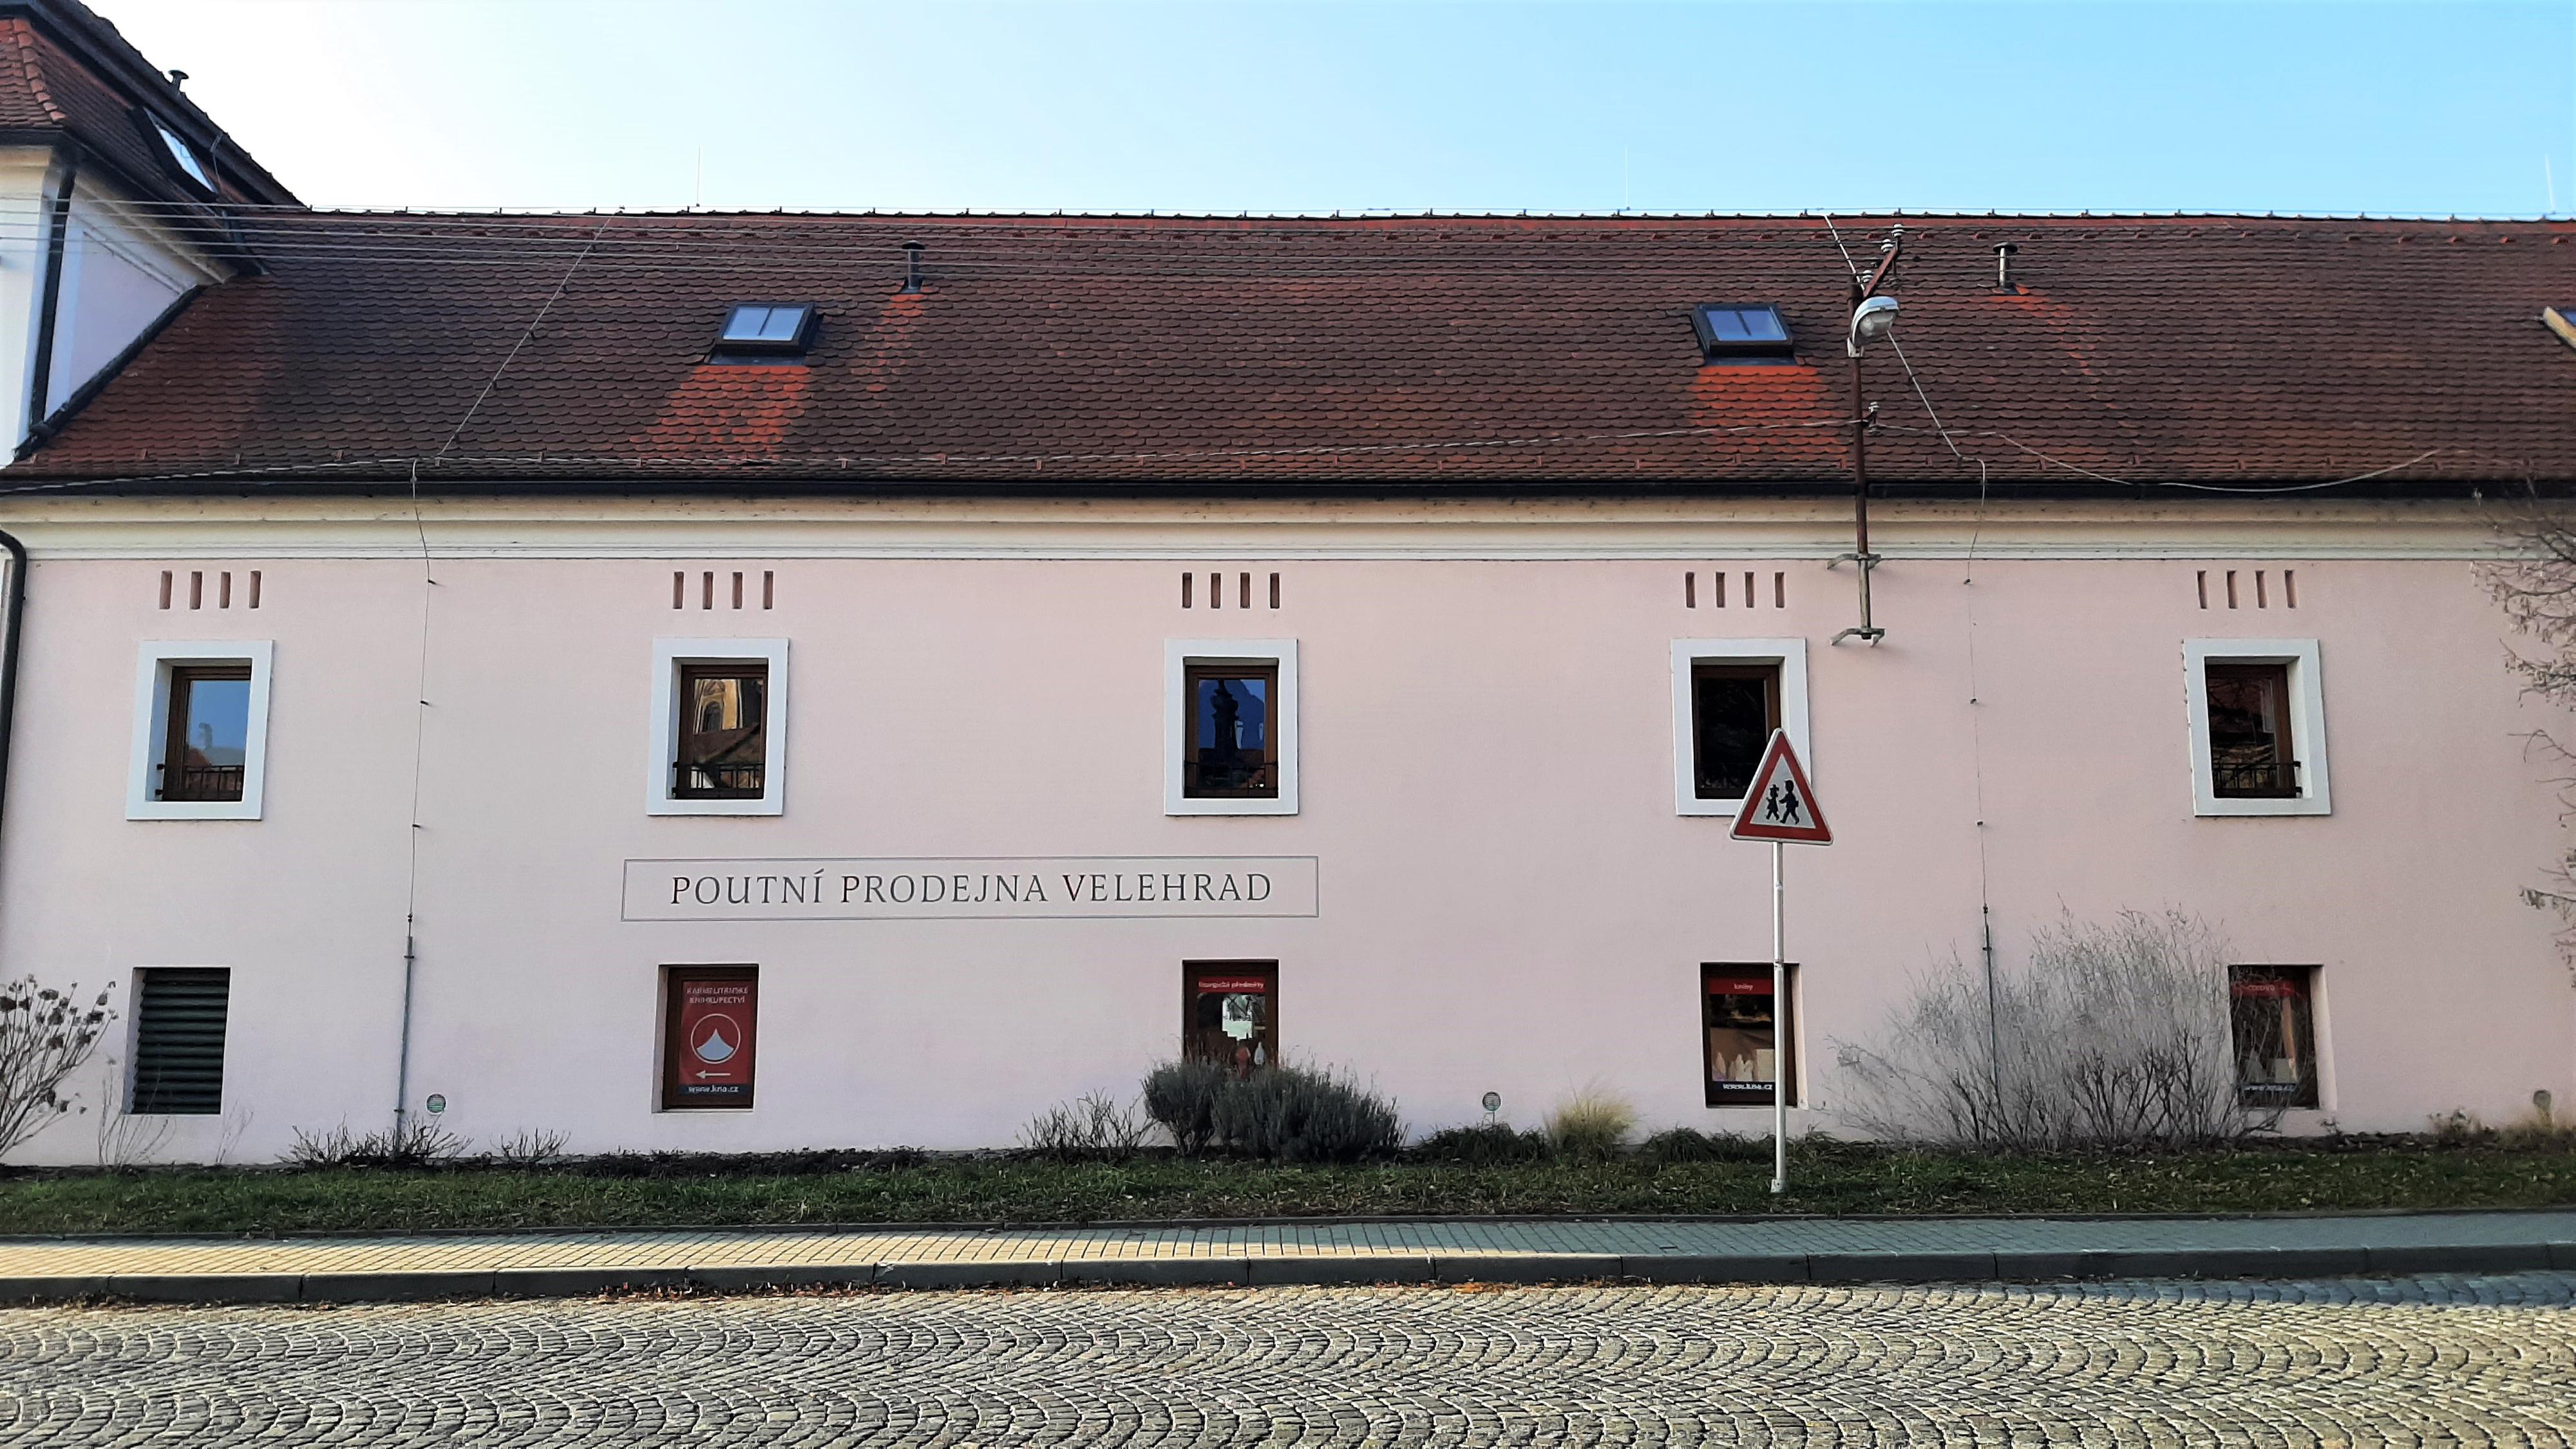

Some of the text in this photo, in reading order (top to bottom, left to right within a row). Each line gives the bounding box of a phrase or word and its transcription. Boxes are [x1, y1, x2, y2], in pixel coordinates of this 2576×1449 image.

[670, 868, 1271, 905] POUTNÍ PRODEJNA VELEHRAD
